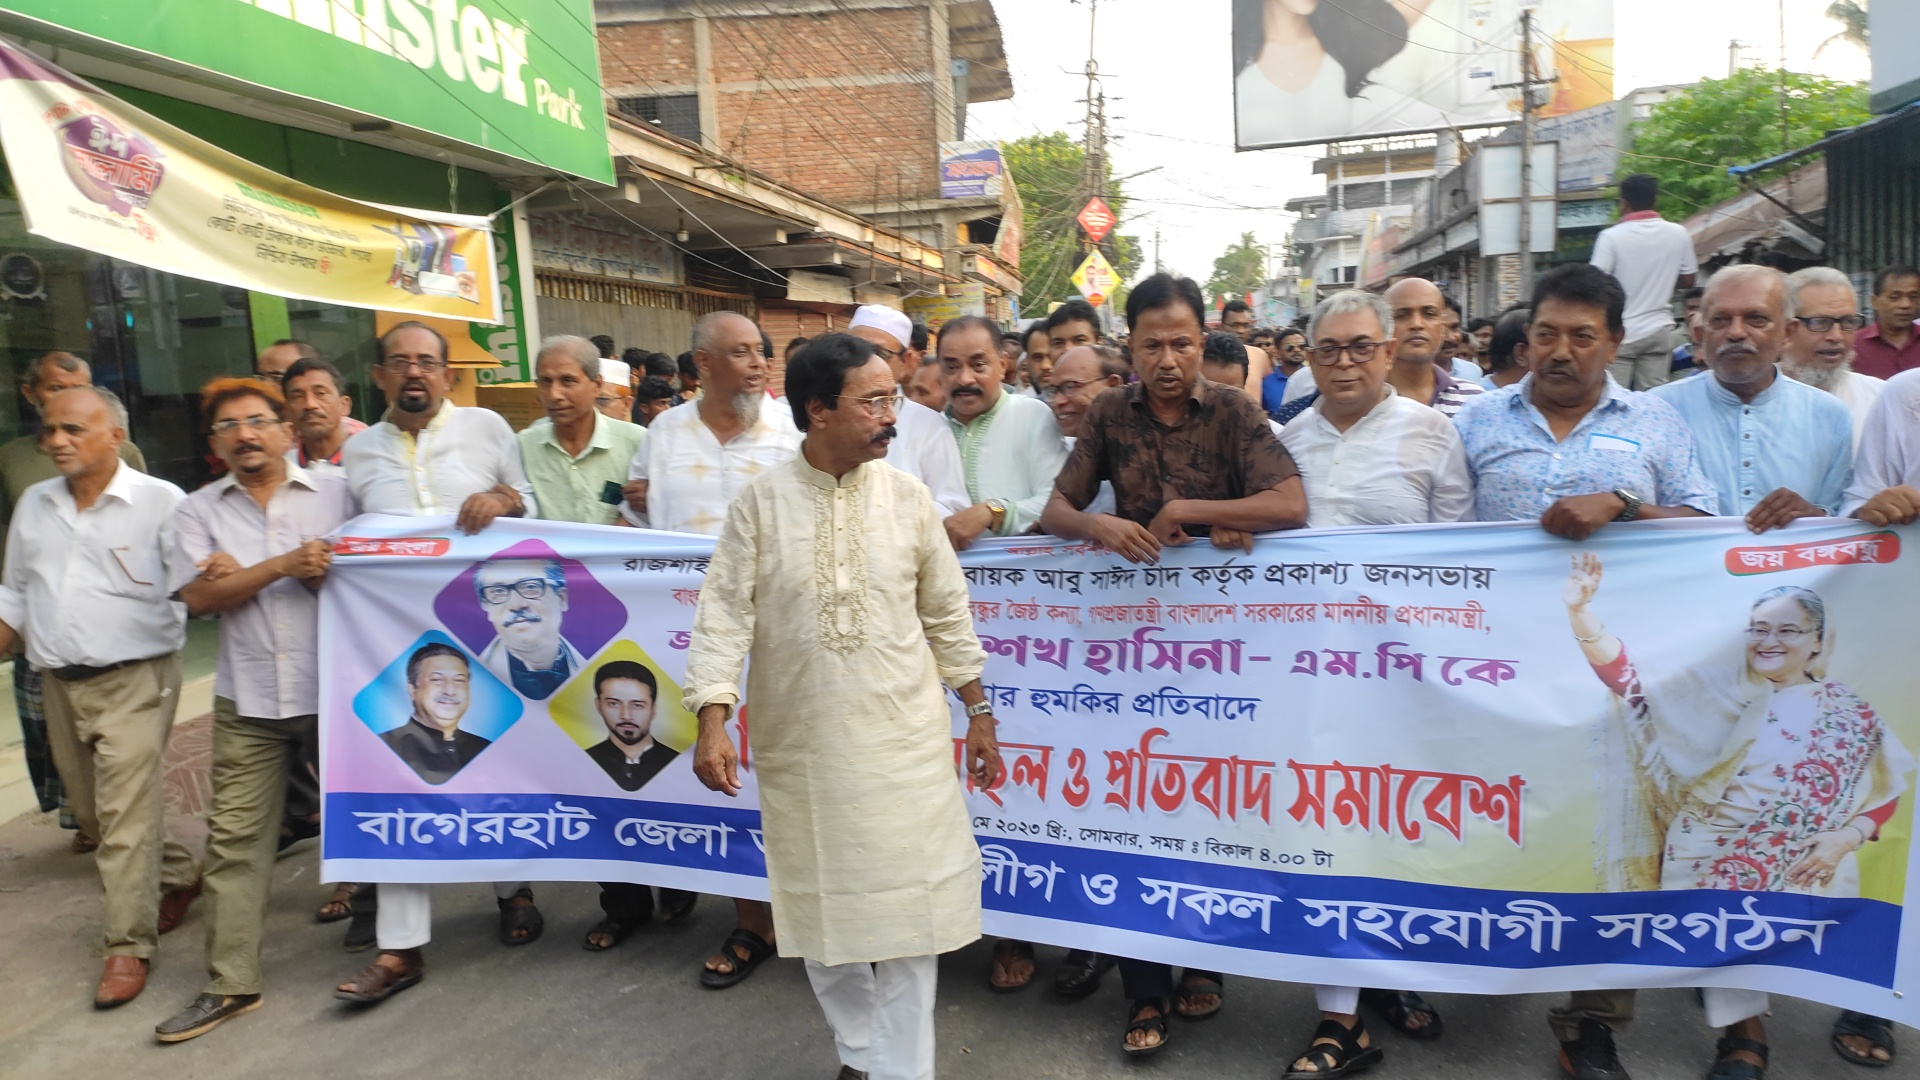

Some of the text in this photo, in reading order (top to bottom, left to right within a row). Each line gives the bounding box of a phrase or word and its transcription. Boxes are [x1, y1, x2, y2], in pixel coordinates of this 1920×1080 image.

[534, 78, 585, 131] Park
[1032, 568, 1085, 596] আবু
[1141, 563, 1184, 588] চাদ
[1188, 556, 1258, 597] কর্তৃক
[1264, 561, 1354, 586] প্রকাশ্য
[1361, 563, 1498, 590] জনসভায়
[1737, 539, 1885, 569] জয় বঙ্গবন্ধু
[1167, 603, 1238, 625] বাংলাদেশ
[1243, 603, 1318, 624] সরকারের
[1322, 595, 1390, 625] মাননীয়
[1394, 600, 1492, 635] প্রধানমন্ত্রী,
[1290, 641, 1427, 682] এম.পি
[1437, 656, 1519, 687] কে
[1028, 683, 1124, 716] হুমকির
[1132, 686, 1262, 722] প্রতিবাদে
[1061, 747, 1091, 808] ও
[1103, 727, 1278, 826] প্রতিবাদ
[1286, 758, 1527, 847] সমাবেশ
[352, 802, 598, 850] বাগেরহাট
[614, 816, 742, 858] জেলা
[972, 816, 993, 830] মে
[996, 818, 1041, 836] ২০২৩
[1079, 827, 1144, 851] সোমবার,
[1150, 835, 1187, 853] সময়
[1204, 837, 1255, 861] বিকাল
[1259, 848, 1306, 866] ৪.০০
[1312, 848, 1335, 868] টা
[1080, 873, 1120, 906] ও
[1137, 876, 1284, 936] সকল
[1296, 897, 1578, 954] সহযোগী
[1592, 896, 1842, 956] সংগঠন
